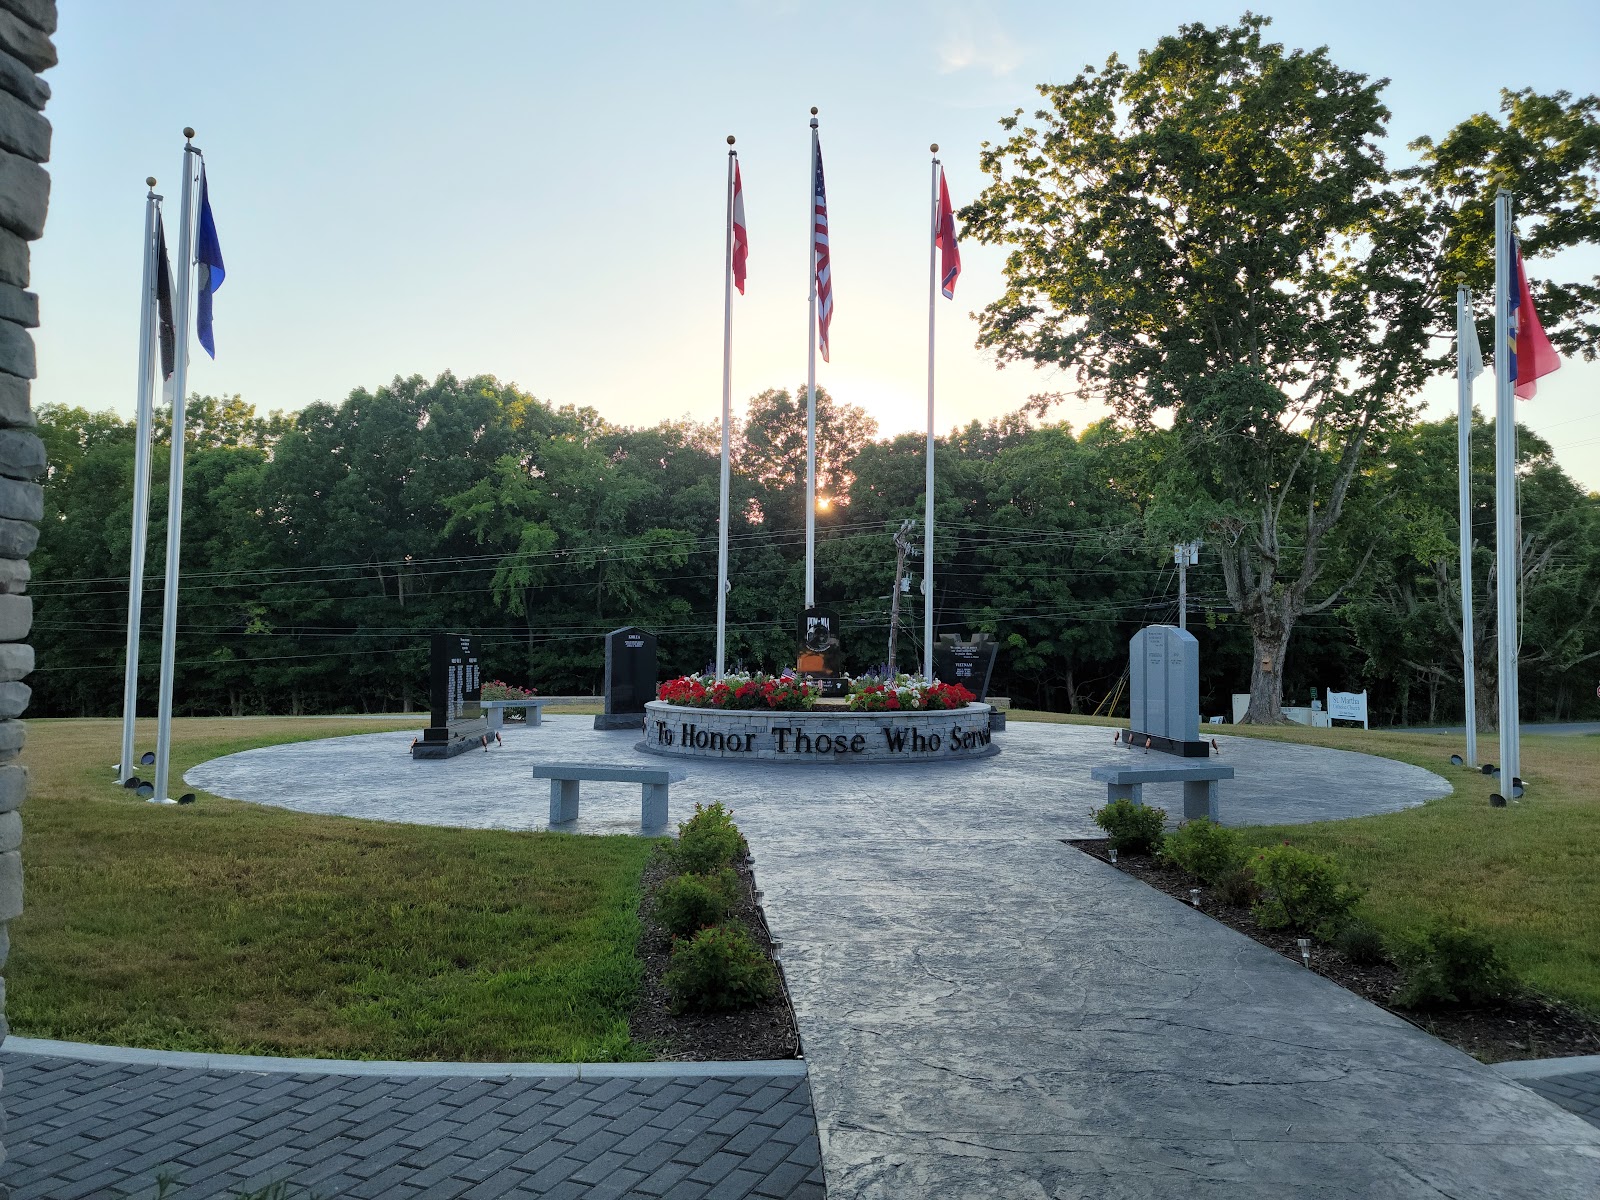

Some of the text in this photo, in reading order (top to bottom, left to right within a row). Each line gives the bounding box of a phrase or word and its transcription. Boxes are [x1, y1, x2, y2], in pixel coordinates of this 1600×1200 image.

[655, 720, 672, 746] To
[681, 722, 756, 752] Honor
[771, 727, 866, 753] Those
[883, 726, 941, 752] Who
